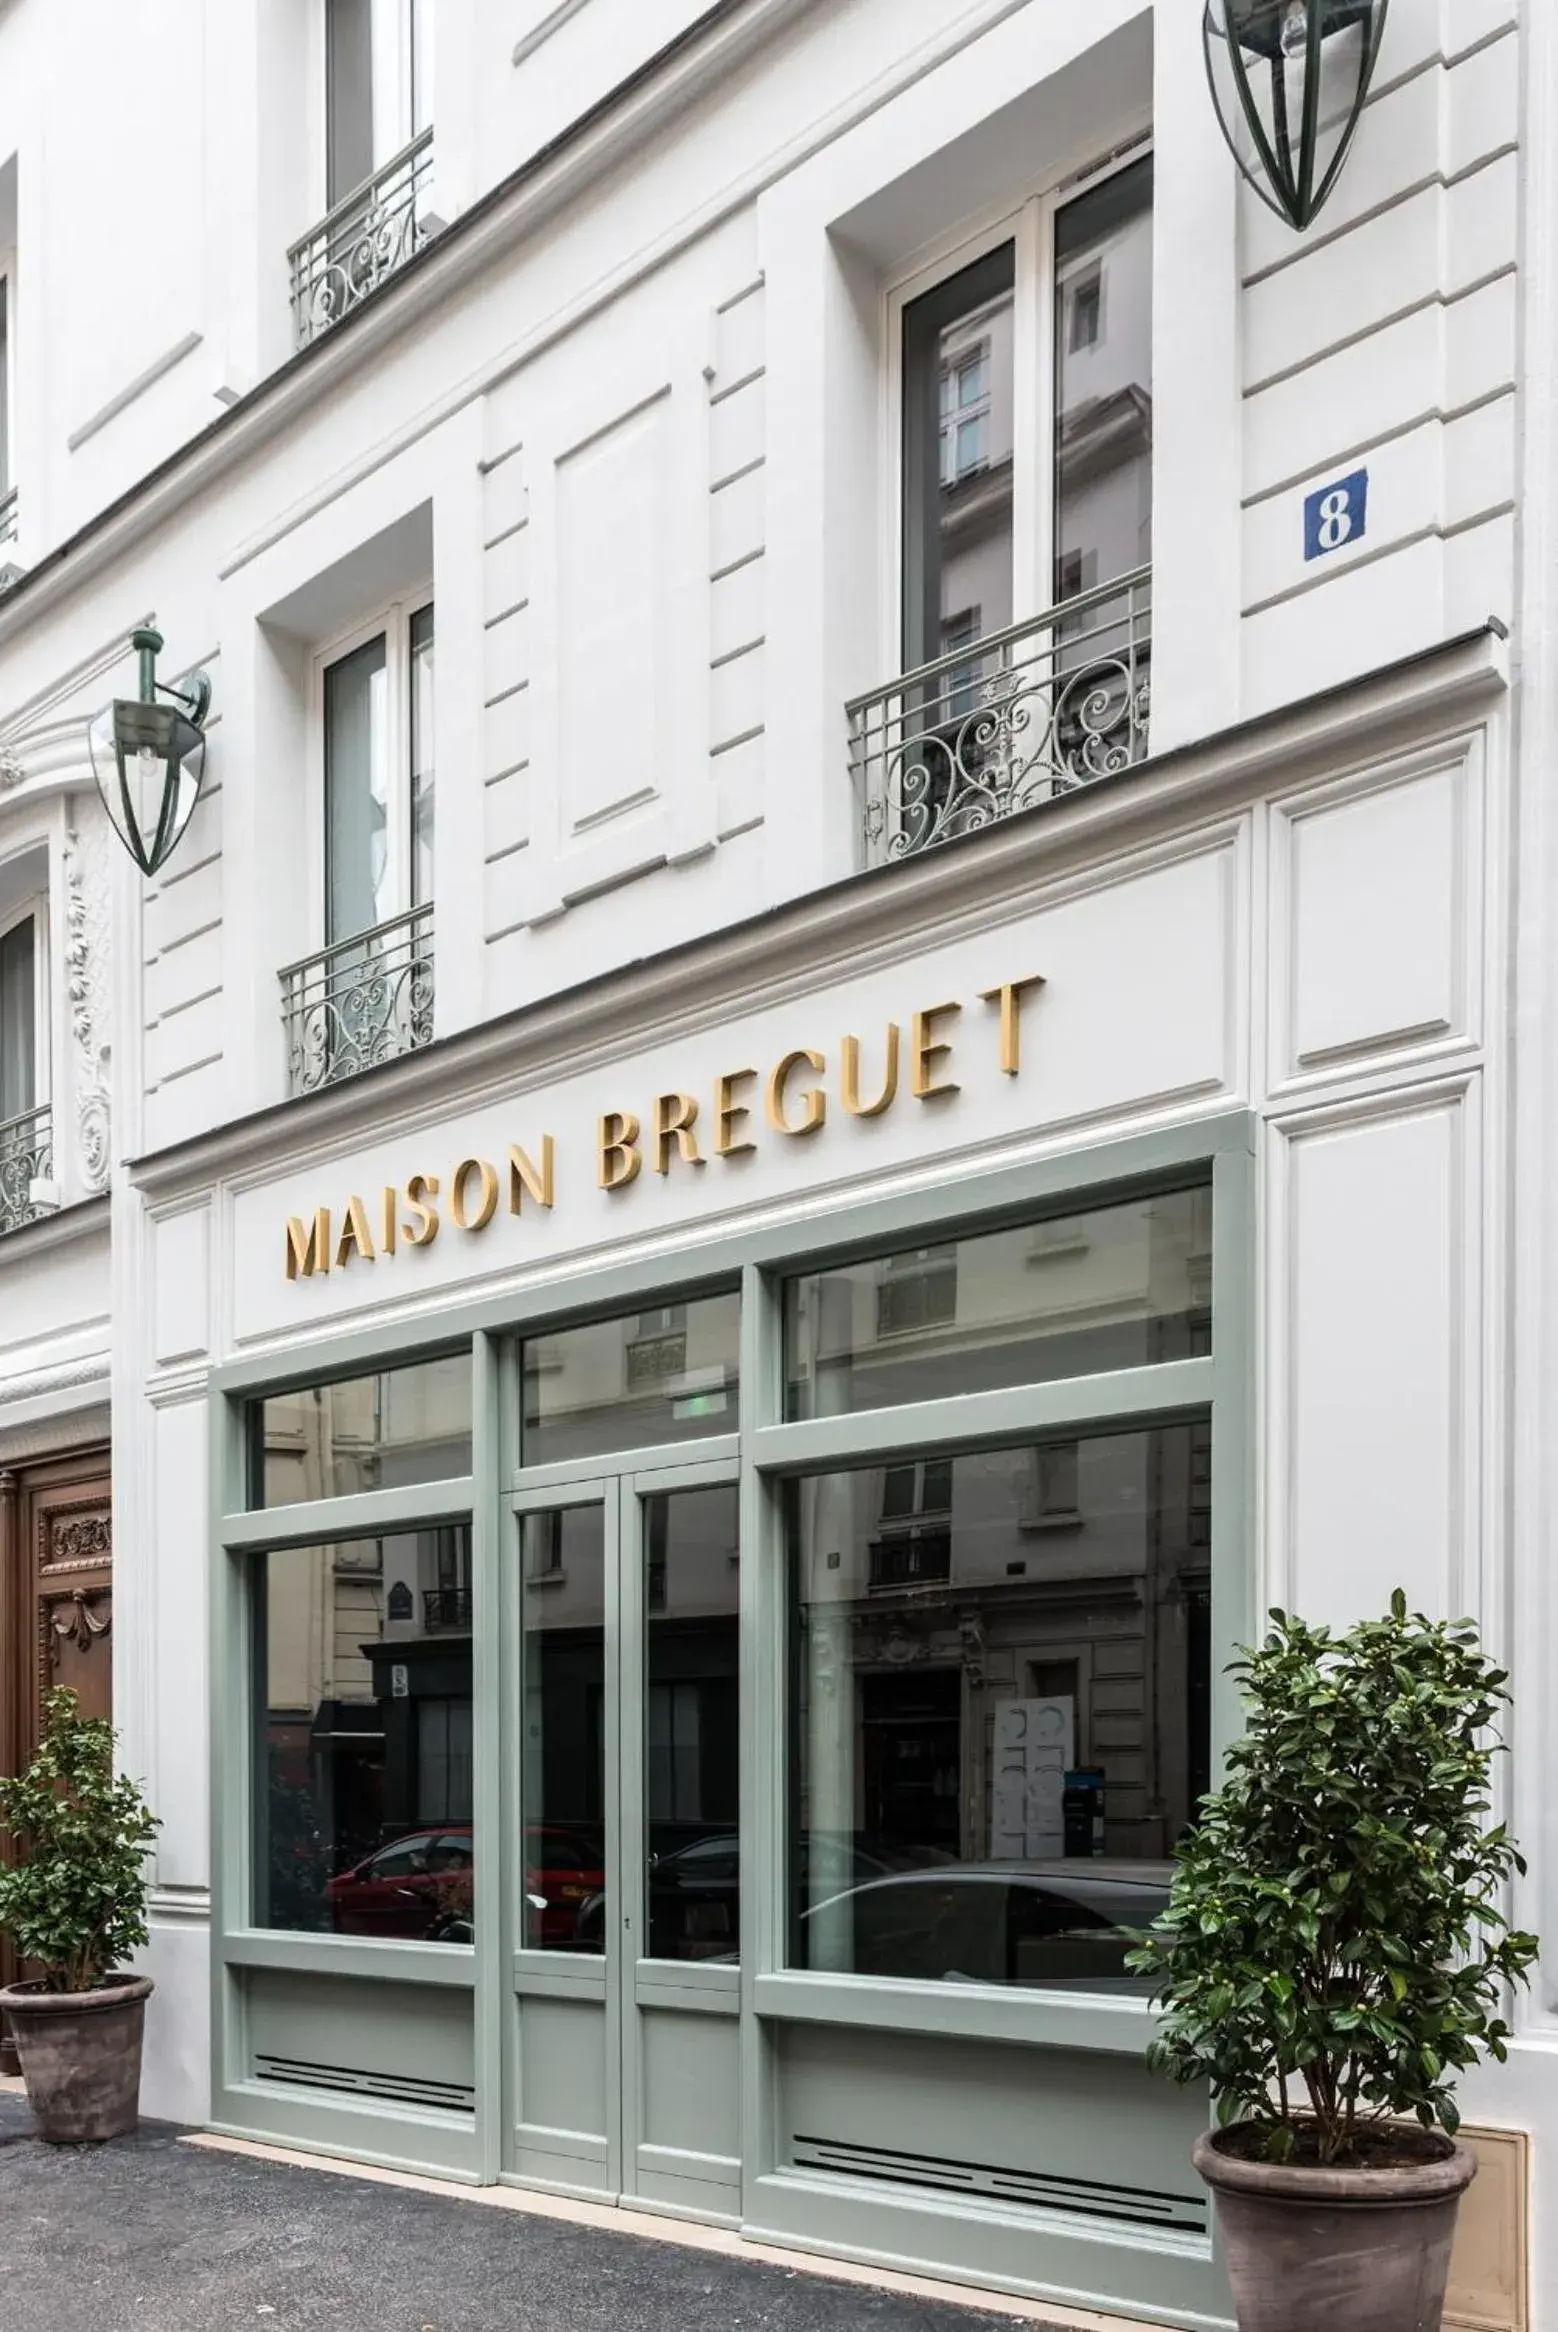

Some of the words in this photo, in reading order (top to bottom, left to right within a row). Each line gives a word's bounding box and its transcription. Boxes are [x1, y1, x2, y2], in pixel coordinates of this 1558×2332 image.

[1318, 489, 1352, 549] 8
[285, 1134, 555, 1281] MAISON
[597, 975, 1047, 1191] BREGUET
